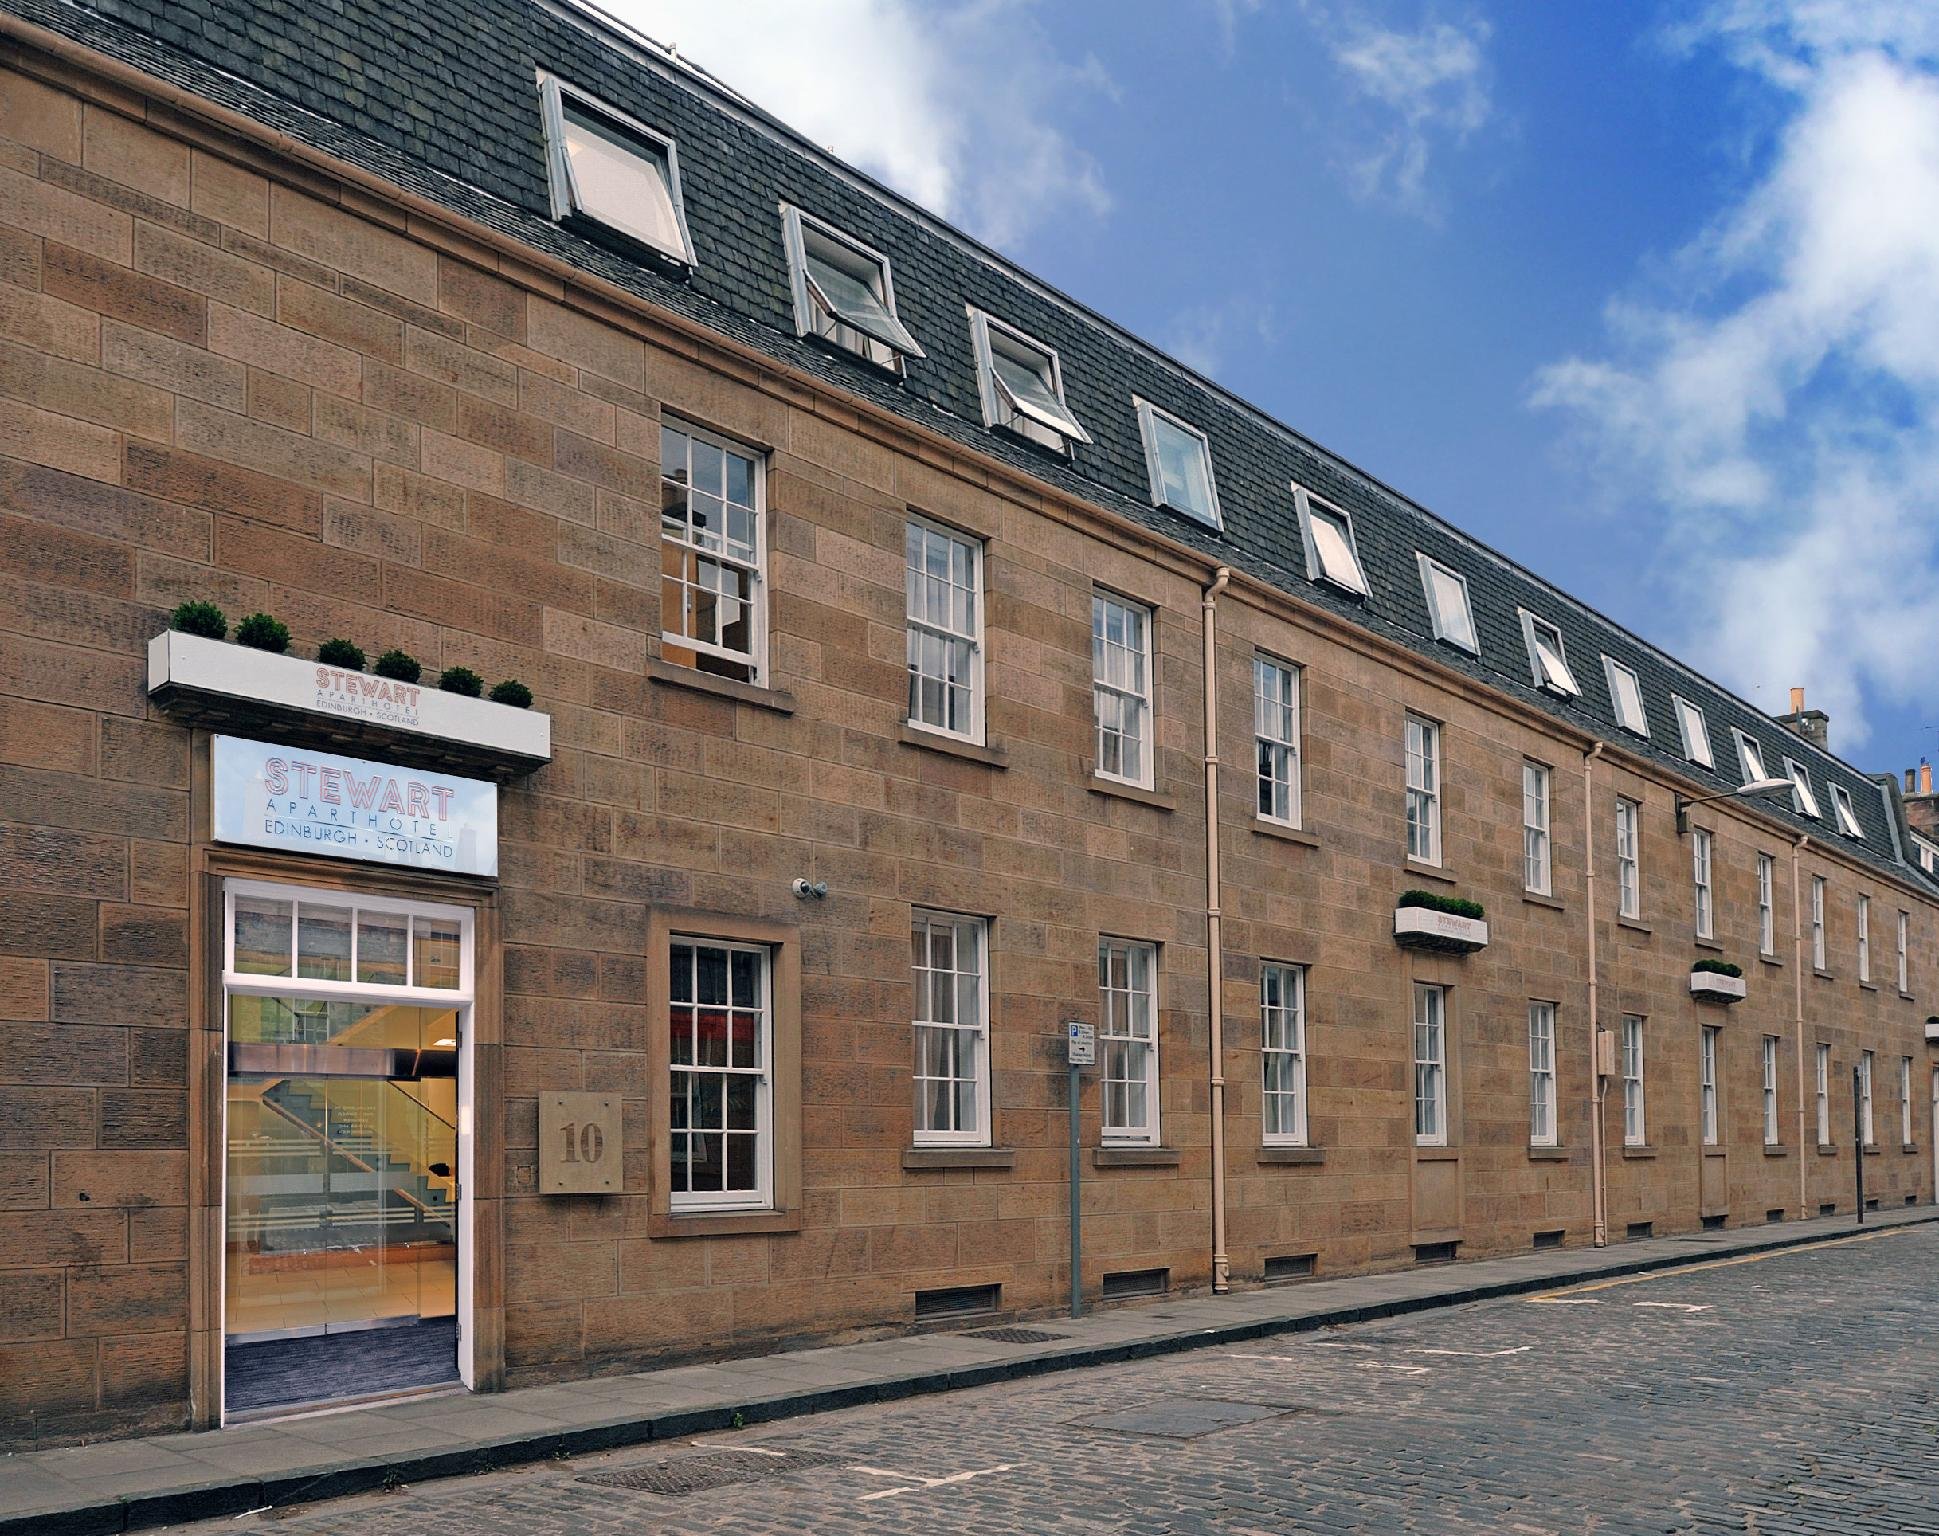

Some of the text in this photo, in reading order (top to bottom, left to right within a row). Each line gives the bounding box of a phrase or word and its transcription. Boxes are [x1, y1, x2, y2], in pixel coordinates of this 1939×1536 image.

[316, 667, 421, 707] STEWART
[316, 700, 419, 726] EDINBURGH SCOTLAND
[264, 757, 455, 821] STEWART
[265, 819, 453, 858] EDINBURGH SCOTLAND
[266, 798, 454, 839] APARTHOTEL
[559, 1122, 603, 1164] 10
